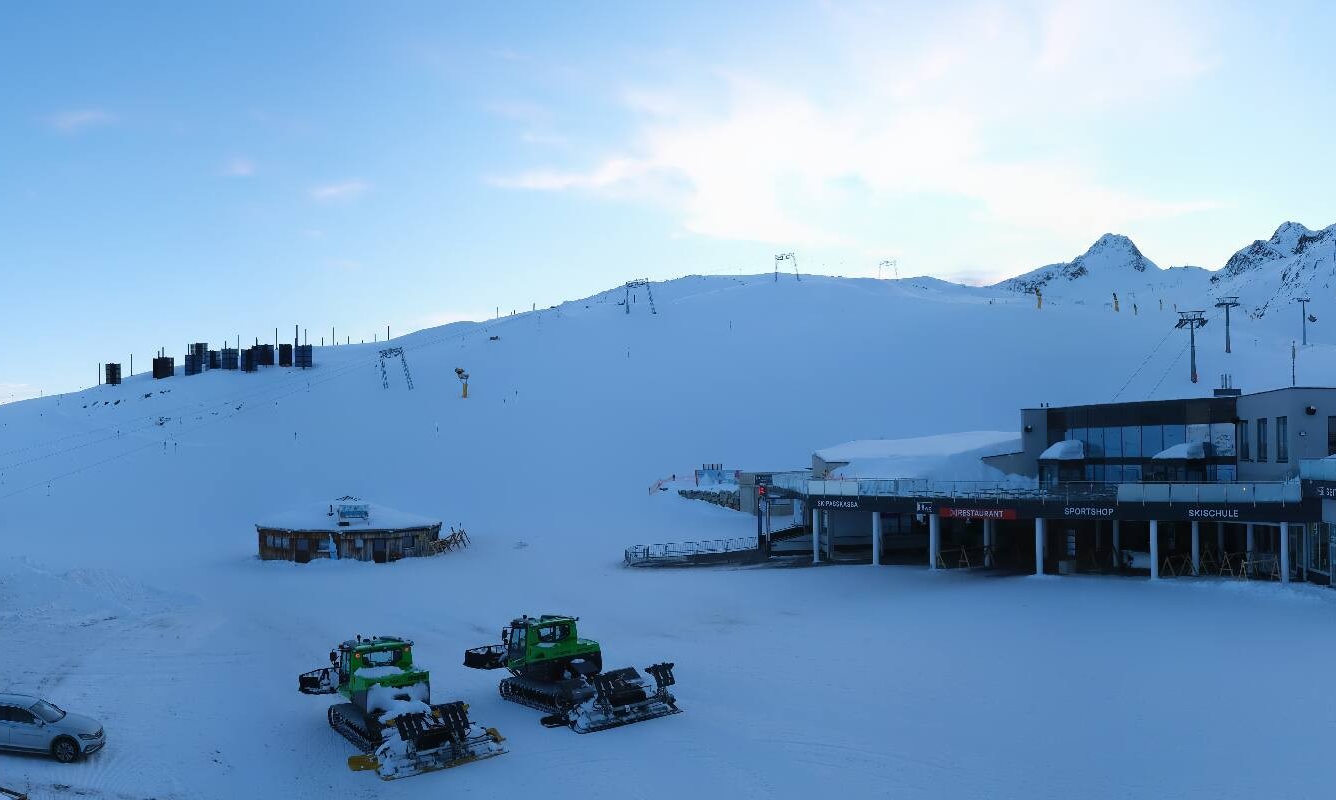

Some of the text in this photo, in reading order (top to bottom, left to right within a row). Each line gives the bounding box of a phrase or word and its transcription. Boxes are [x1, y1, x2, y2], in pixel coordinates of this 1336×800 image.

[957, 508, 1004, 518] RESTAURANT
[1064, 507, 1114, 516] SPORTSHOP
[1188, 509, 1239, 518] SKISCHULE
